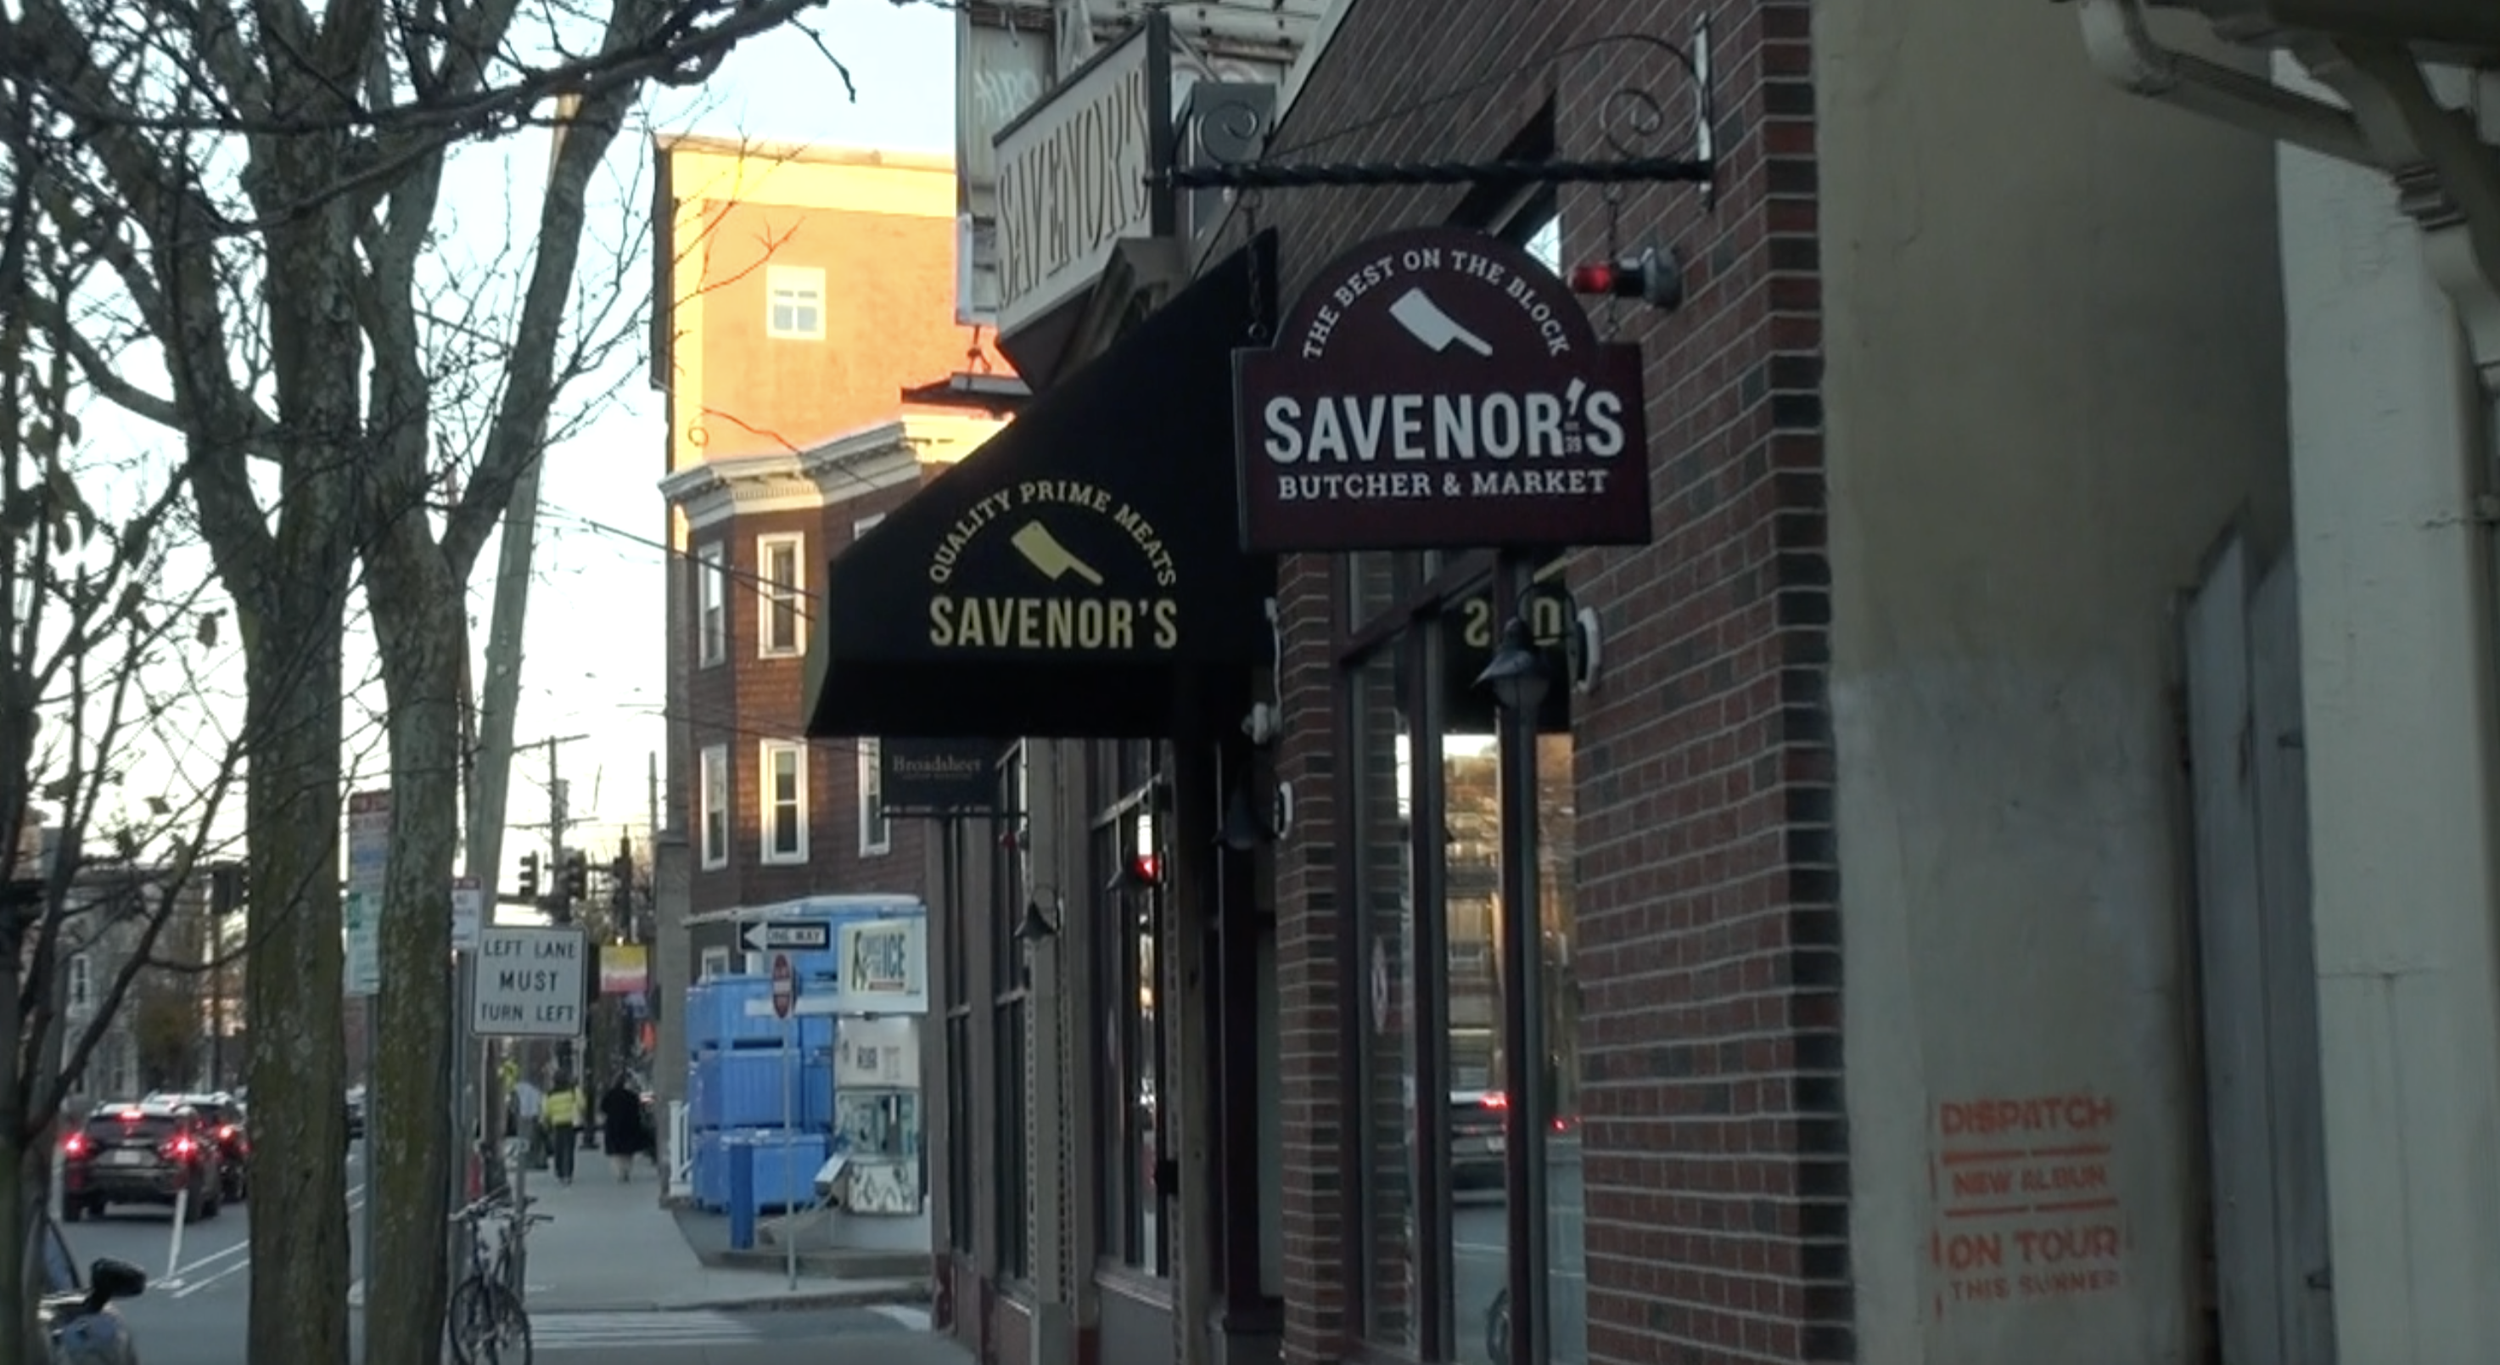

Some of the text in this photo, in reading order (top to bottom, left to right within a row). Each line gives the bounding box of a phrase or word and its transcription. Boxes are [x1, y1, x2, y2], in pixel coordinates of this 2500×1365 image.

[998, 62, 1152, 309] SAVENOR'S
[1302, 248, 1572, 360] THE BEST ON THE BLOCK
[1264, 377, 1625, 464] SAVENOR'S
[1278, 469, 1610, 501] BUTCHER & MARKET
[929, 480, 1177, 587] QUALITY PRIME MEATS
[929, 594, 1179, 650] SAVENOR'S
[892, 753, 982, 773] Broadsheet
[484, 939, 575, 959] LEFT LANE
[499, 970, 559, 992] MUST
[481, 1003, 575, 1022] TURN LEFT
[1940, 1094, 2116, 1136] DISPATCH
[1952, 1170, 2012, 1196] NEW
[1947, 1225, 2120, 1270] ON TOUR
[1949, 1277, 2010, 1301] THIS
